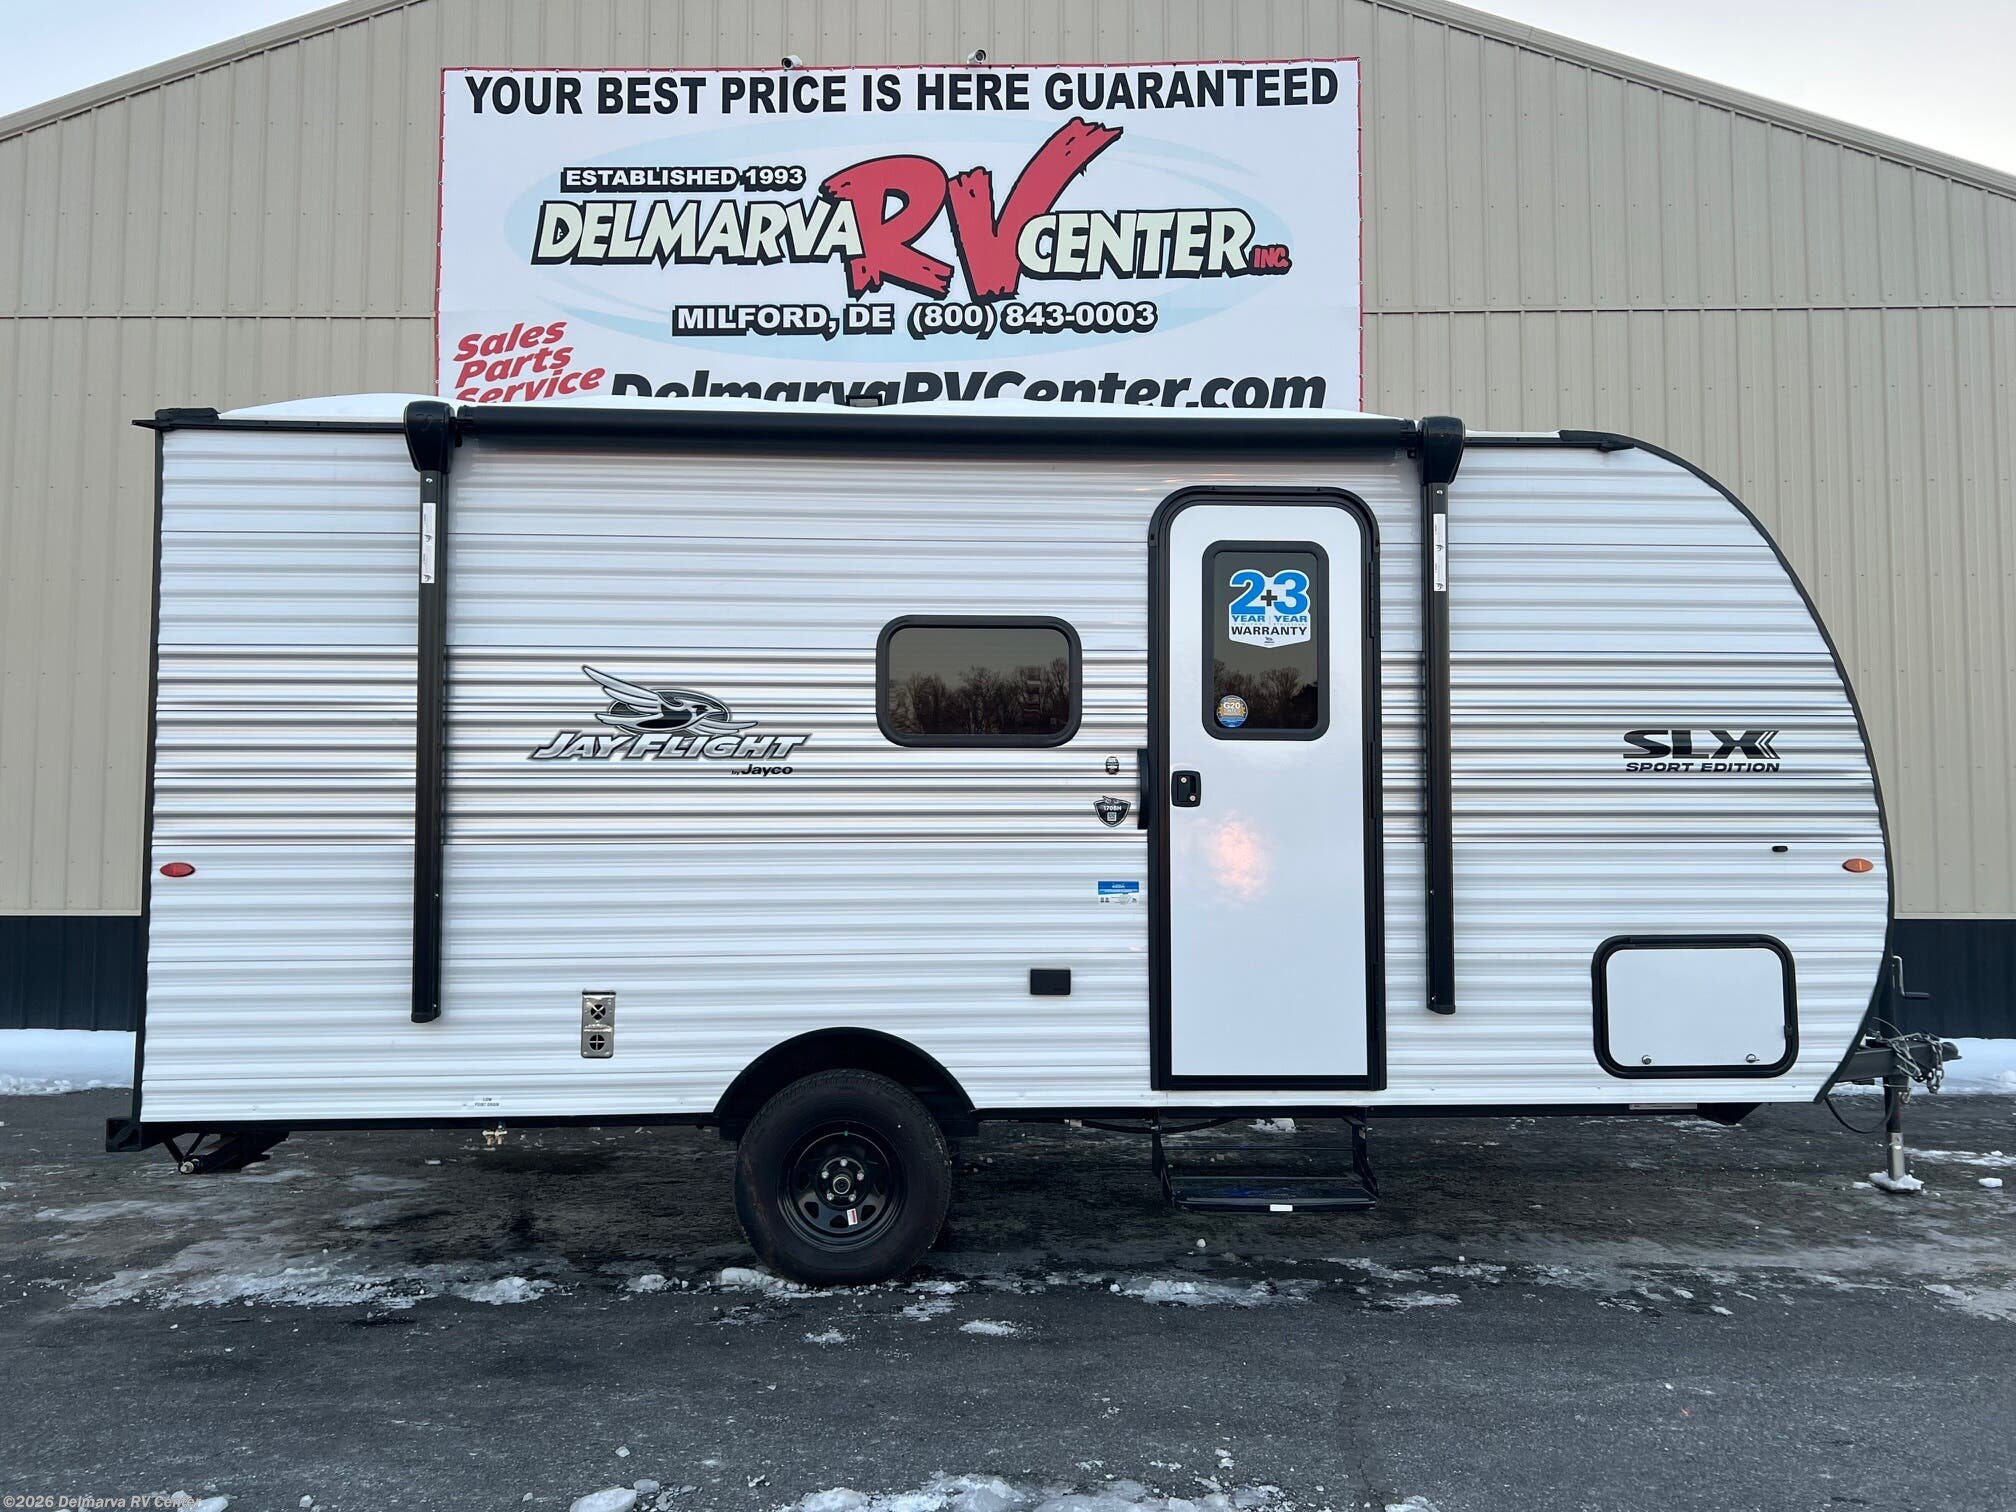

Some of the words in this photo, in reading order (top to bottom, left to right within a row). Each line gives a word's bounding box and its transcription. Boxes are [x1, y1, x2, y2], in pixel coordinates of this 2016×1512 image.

[465, 76, 582, 115] YOUR
[598, 76, 707, 115] BEST
[722, 74, 846, 113] PRICE
[863, 73, 900, 113] IS
[917, 73, 1030, 111] HERE
[1044, 67, 1339, 111] GUARANTEED
[564, 167, 738, 188] ESTABLISHED
[745, 166, 804, 187] 1993
[534, 199, 865, 266] DELMARVA
[821, 117, 1123, 299] RV
[1016, 209, 1255, 280] CENTER
[1253, 246, 1290, 274] INC.
[676, 306, 838, 340] MILFORD,
[848, 305, 893, 329] DE
[912, 305, 996, 335] (800)
[1004, 304, 1156, 328] 843-0003
[453, 321, 568, 361] Sales
[454, 347, 574, 389] Parts
[1231, 626, 1308, 636] WARRANTY
[1232, 615, 1266, 623] YEAR
[1273, 615, 1308, 623] YEAR
[1623, 729, 1781, 760] SLX
[741, 763, 794, 777] Jayco
[1625, 762, 1695, 773] SPORT
[1699, 762, 1781, 773] EDITION
